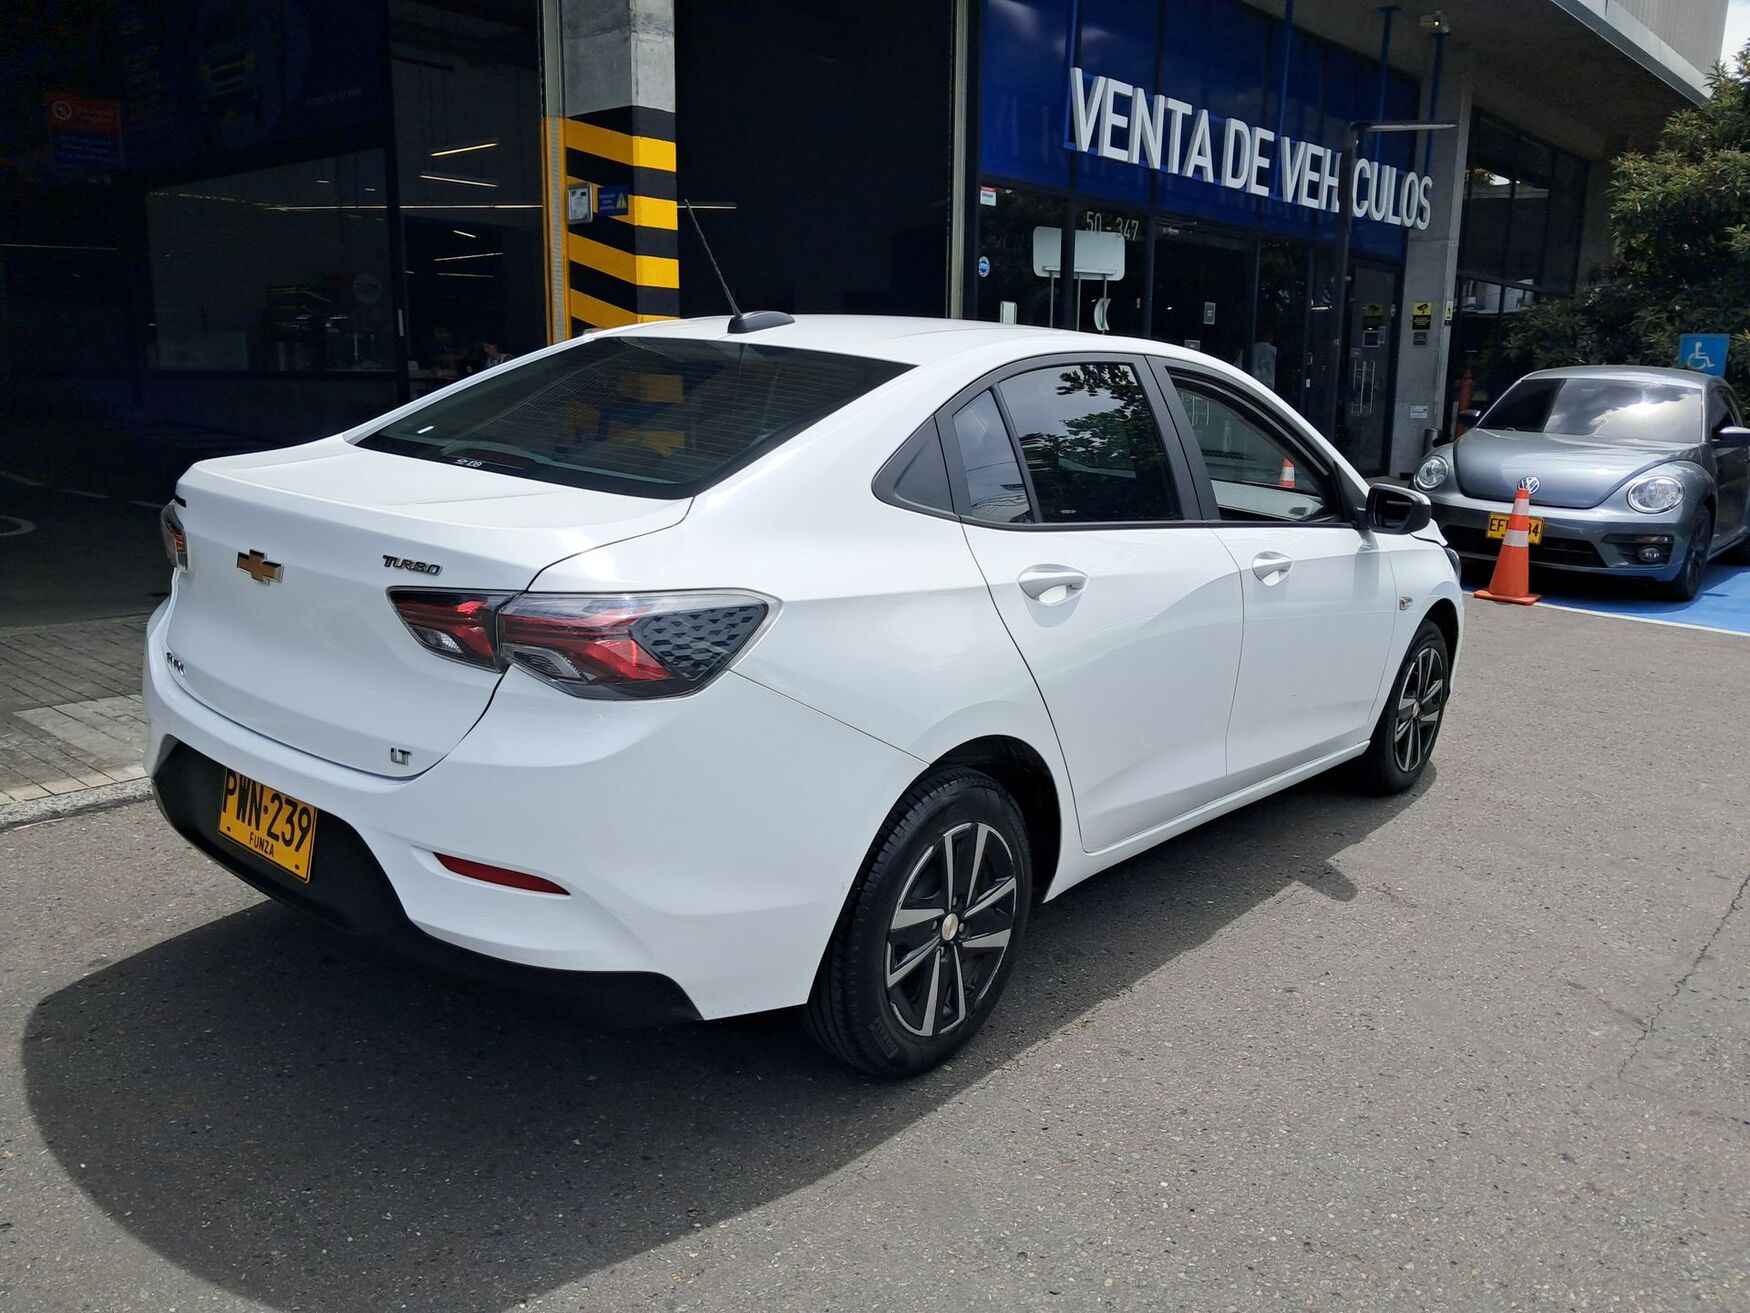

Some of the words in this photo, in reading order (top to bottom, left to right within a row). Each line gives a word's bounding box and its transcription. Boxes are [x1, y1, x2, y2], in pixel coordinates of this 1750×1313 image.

[1070, 67, 1214, 183] VENTA
[1221, 118, 1275, 197] DE
[1281, 136, 1433, 231] VEHCULOS
[382, 555, 443, 576] TURBO
[390, 747, 412, 766] LT
[249, 832, 275, 857] FUNZA
